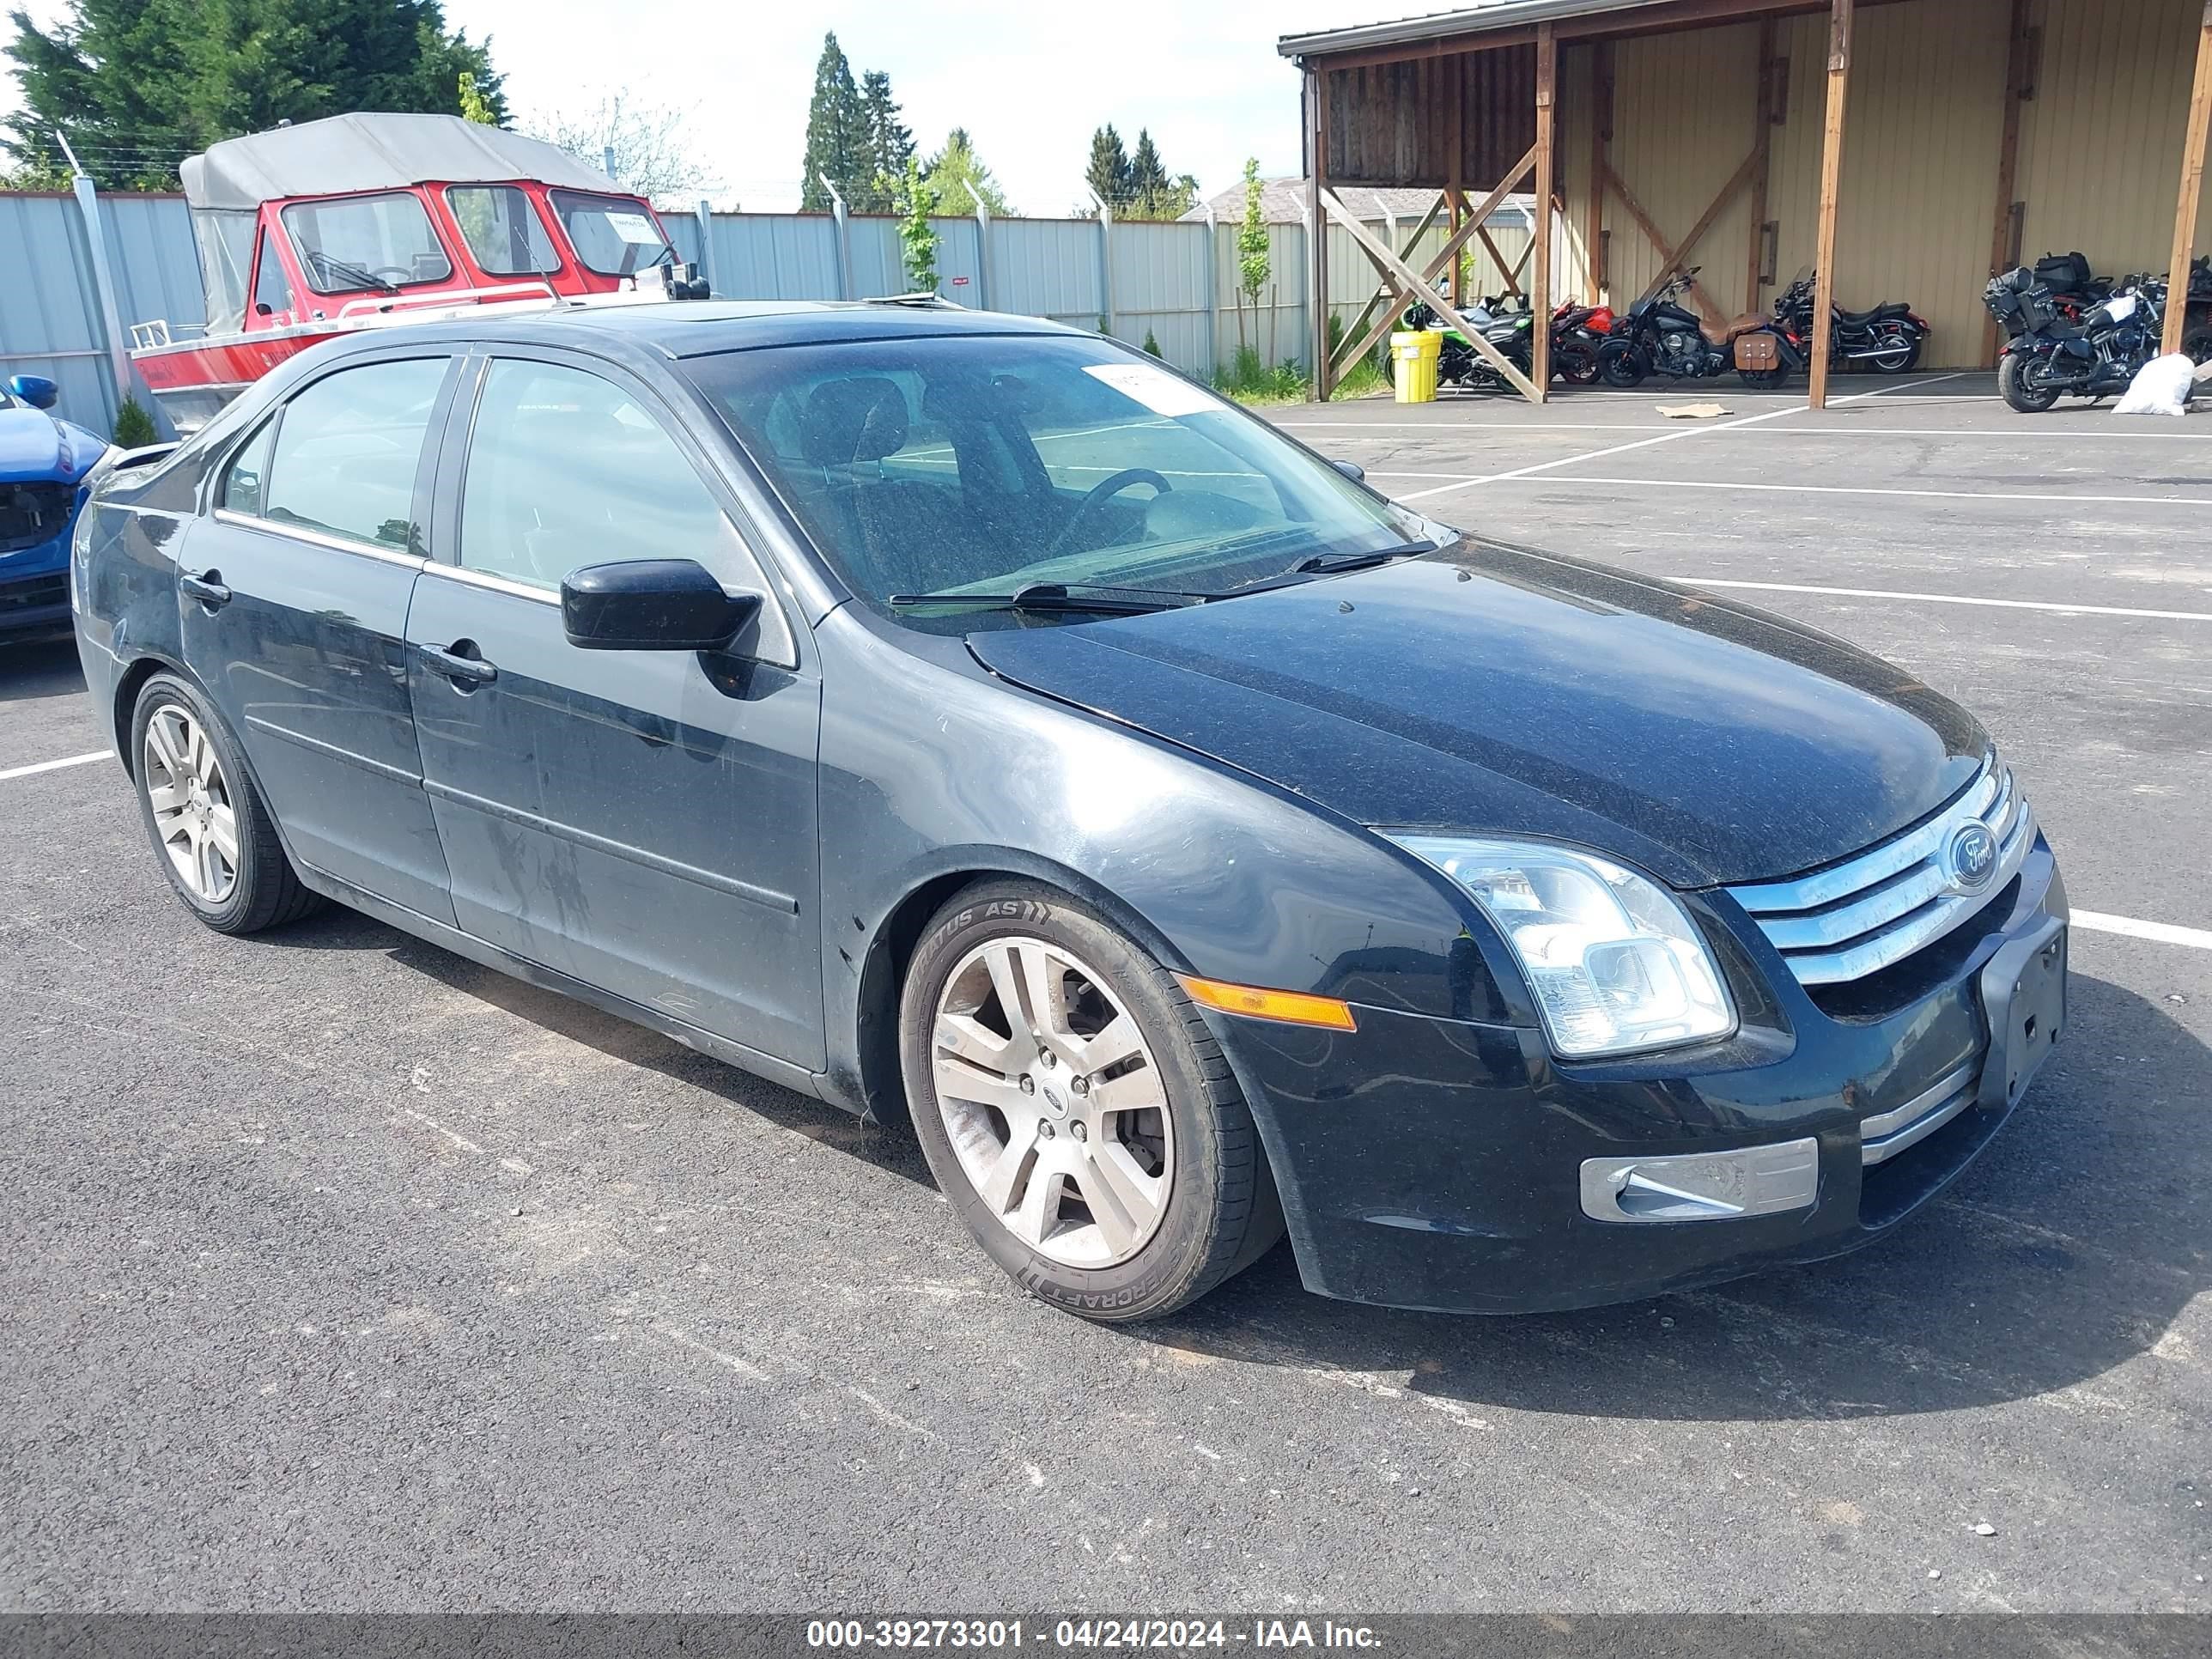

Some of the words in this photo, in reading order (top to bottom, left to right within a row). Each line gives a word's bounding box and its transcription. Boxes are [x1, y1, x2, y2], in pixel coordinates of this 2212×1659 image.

[1965, 836, 1993, 872] Ford
[909, 908, 974, 1011] STRATUS
[985, 901, 1020, 917] AS
